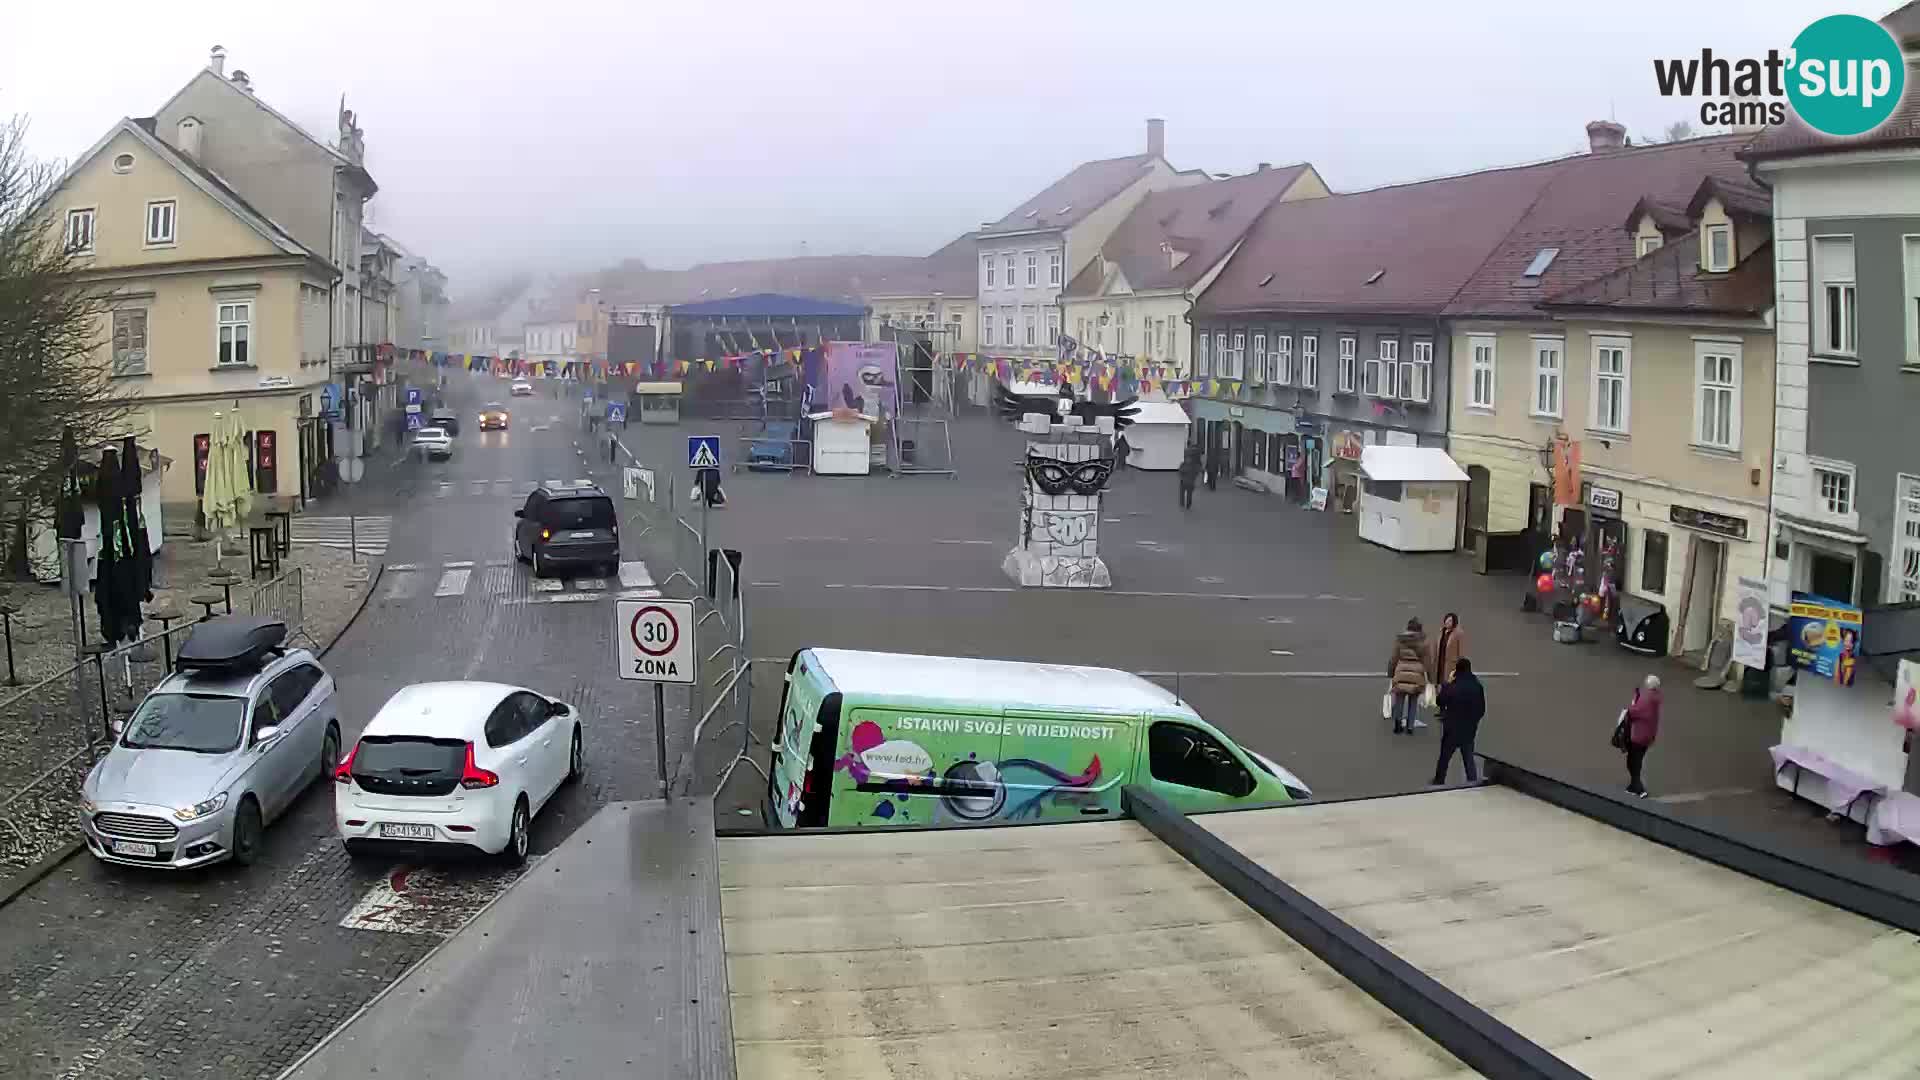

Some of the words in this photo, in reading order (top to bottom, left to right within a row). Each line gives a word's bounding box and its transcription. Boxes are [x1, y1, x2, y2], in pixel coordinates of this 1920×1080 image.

[643, 621, 668, 643] 30
[634, 658, 679, 677] ZONA
[896, 716, 960, 734] ISTAKNI
[964, 720, 1013, 736] SVOJE
[1016, 723, 1114, 740] VRIJEDNOSTI
